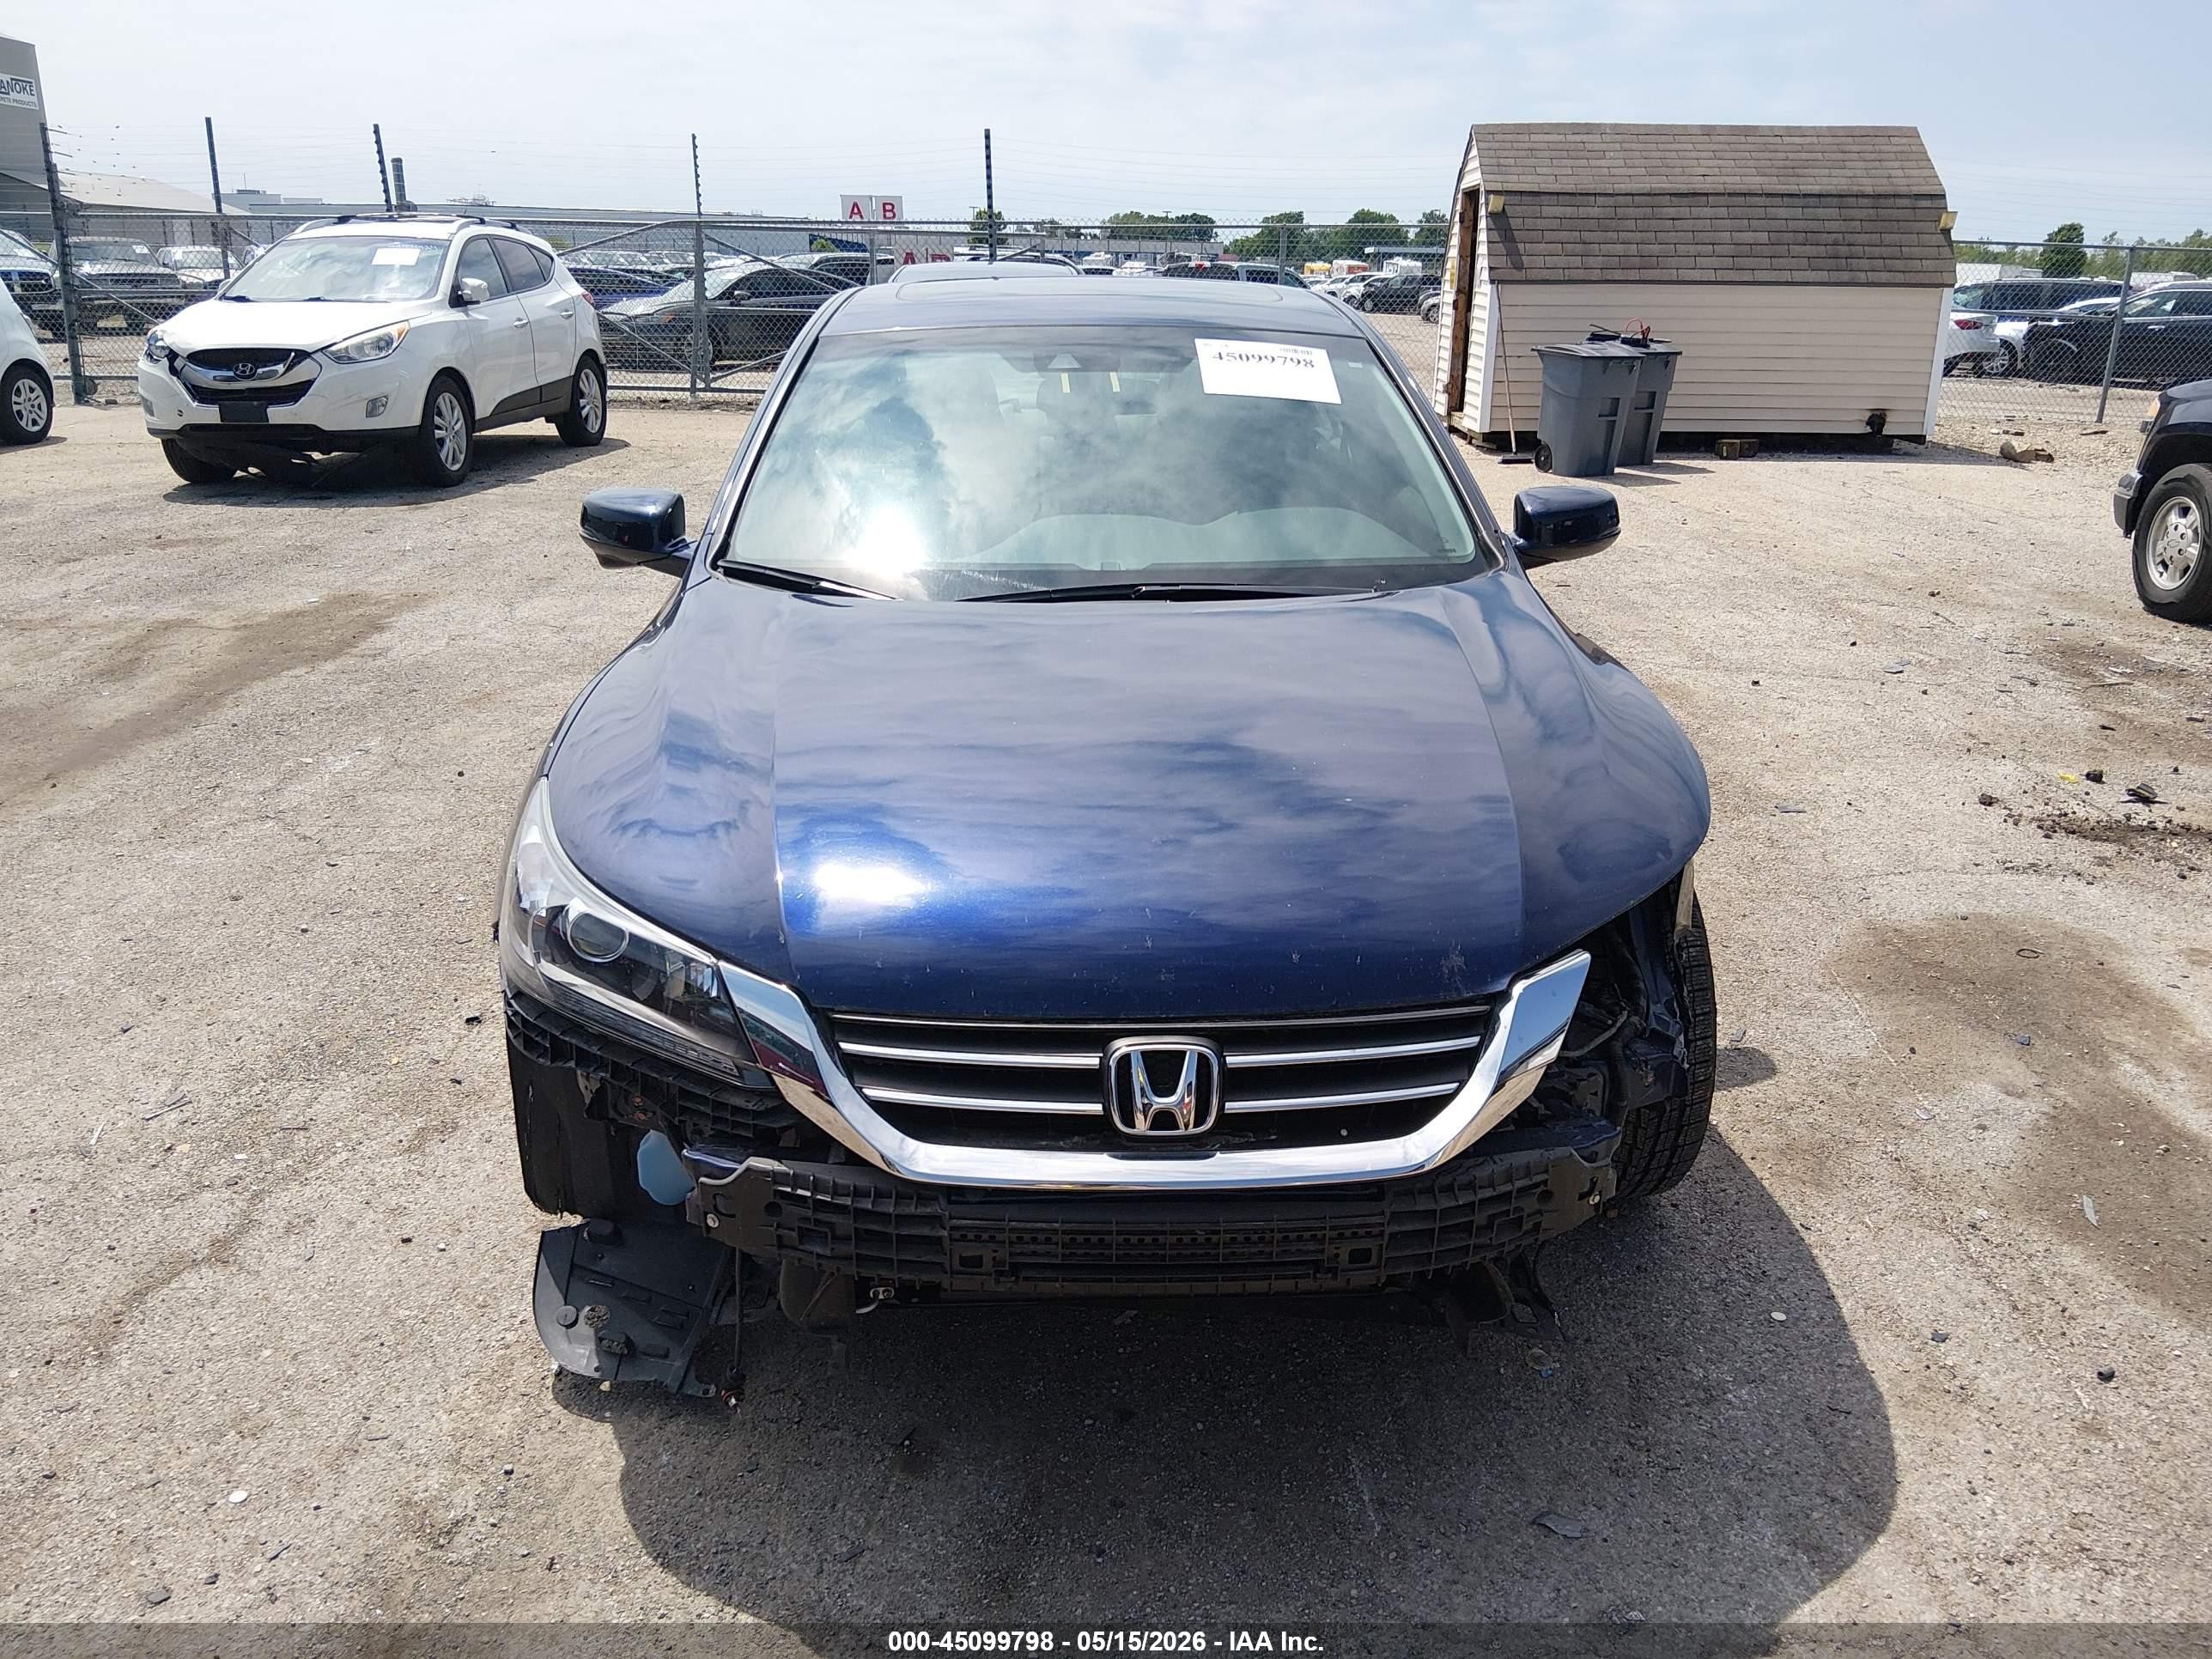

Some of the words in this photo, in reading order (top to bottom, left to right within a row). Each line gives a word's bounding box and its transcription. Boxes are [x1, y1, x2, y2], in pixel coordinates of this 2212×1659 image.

[848, 201, 865, 220] A
[882, 202, 896, 220] B
[1212, 351, 1315, 368] 45099798
